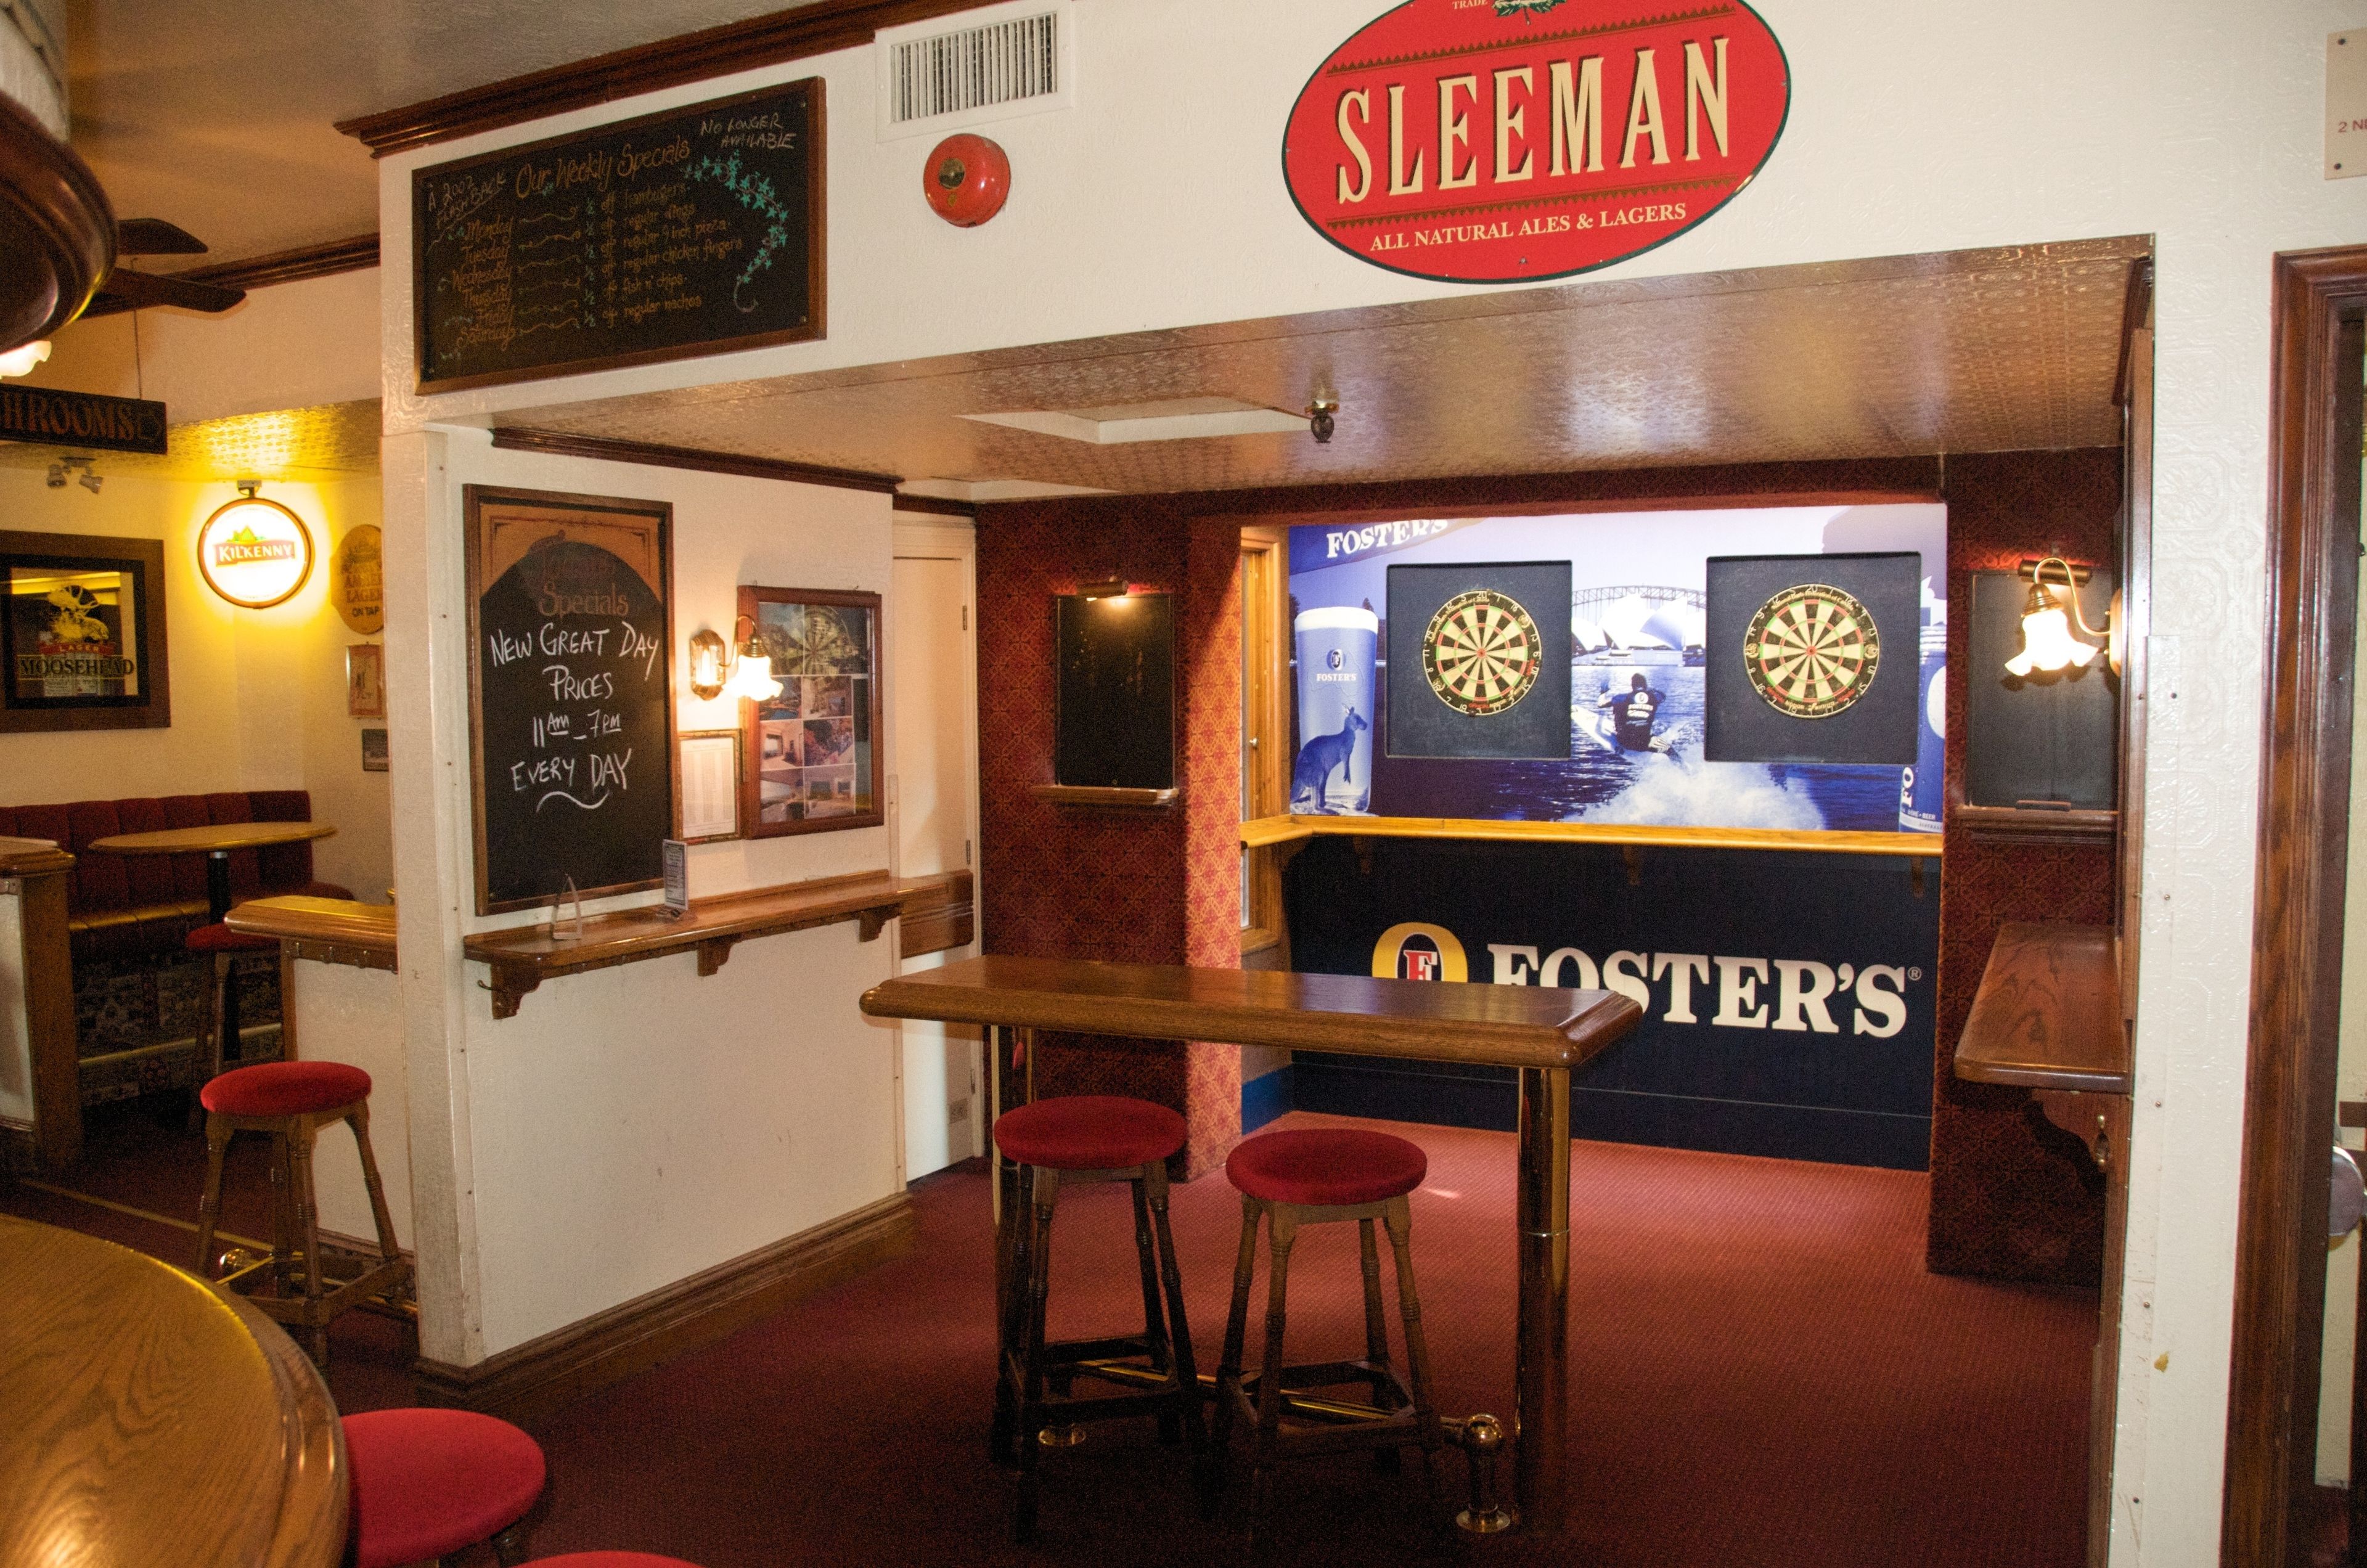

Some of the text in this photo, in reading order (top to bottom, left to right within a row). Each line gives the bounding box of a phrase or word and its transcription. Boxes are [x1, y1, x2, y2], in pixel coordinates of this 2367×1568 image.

[700, 112, 784, 136] NO LONGER
[1336, 37, 1729, 205] SLEEMAN
[2338, 121, 2347, 133] 2
[720, 132, 797, 149] AVAILABLE
[515, 134, 690, 199] Our Weekly Specials
[464, 214, 514, 244] Monday
[1370, 203, 1686, 251] ALL NATURAL ALES & LAGERS
[460, 239, 511, 269] Tuesday
[452, 264, 513, 292] Wednesday
[219, 544, 292, 562] KILKENNY
[351, 606, 380, 618] ON TAP
[538, 580, 629, 619] Specials
[59, 644, 99, 653] LAGER
[490, 621, 660, 681] NEW GREAT DAY
[20, 658, 134, 676] MOOSEHEAD
[542, 664, 613, 701] PRICES
[510, 748, 633, 791] EVERY DAY
